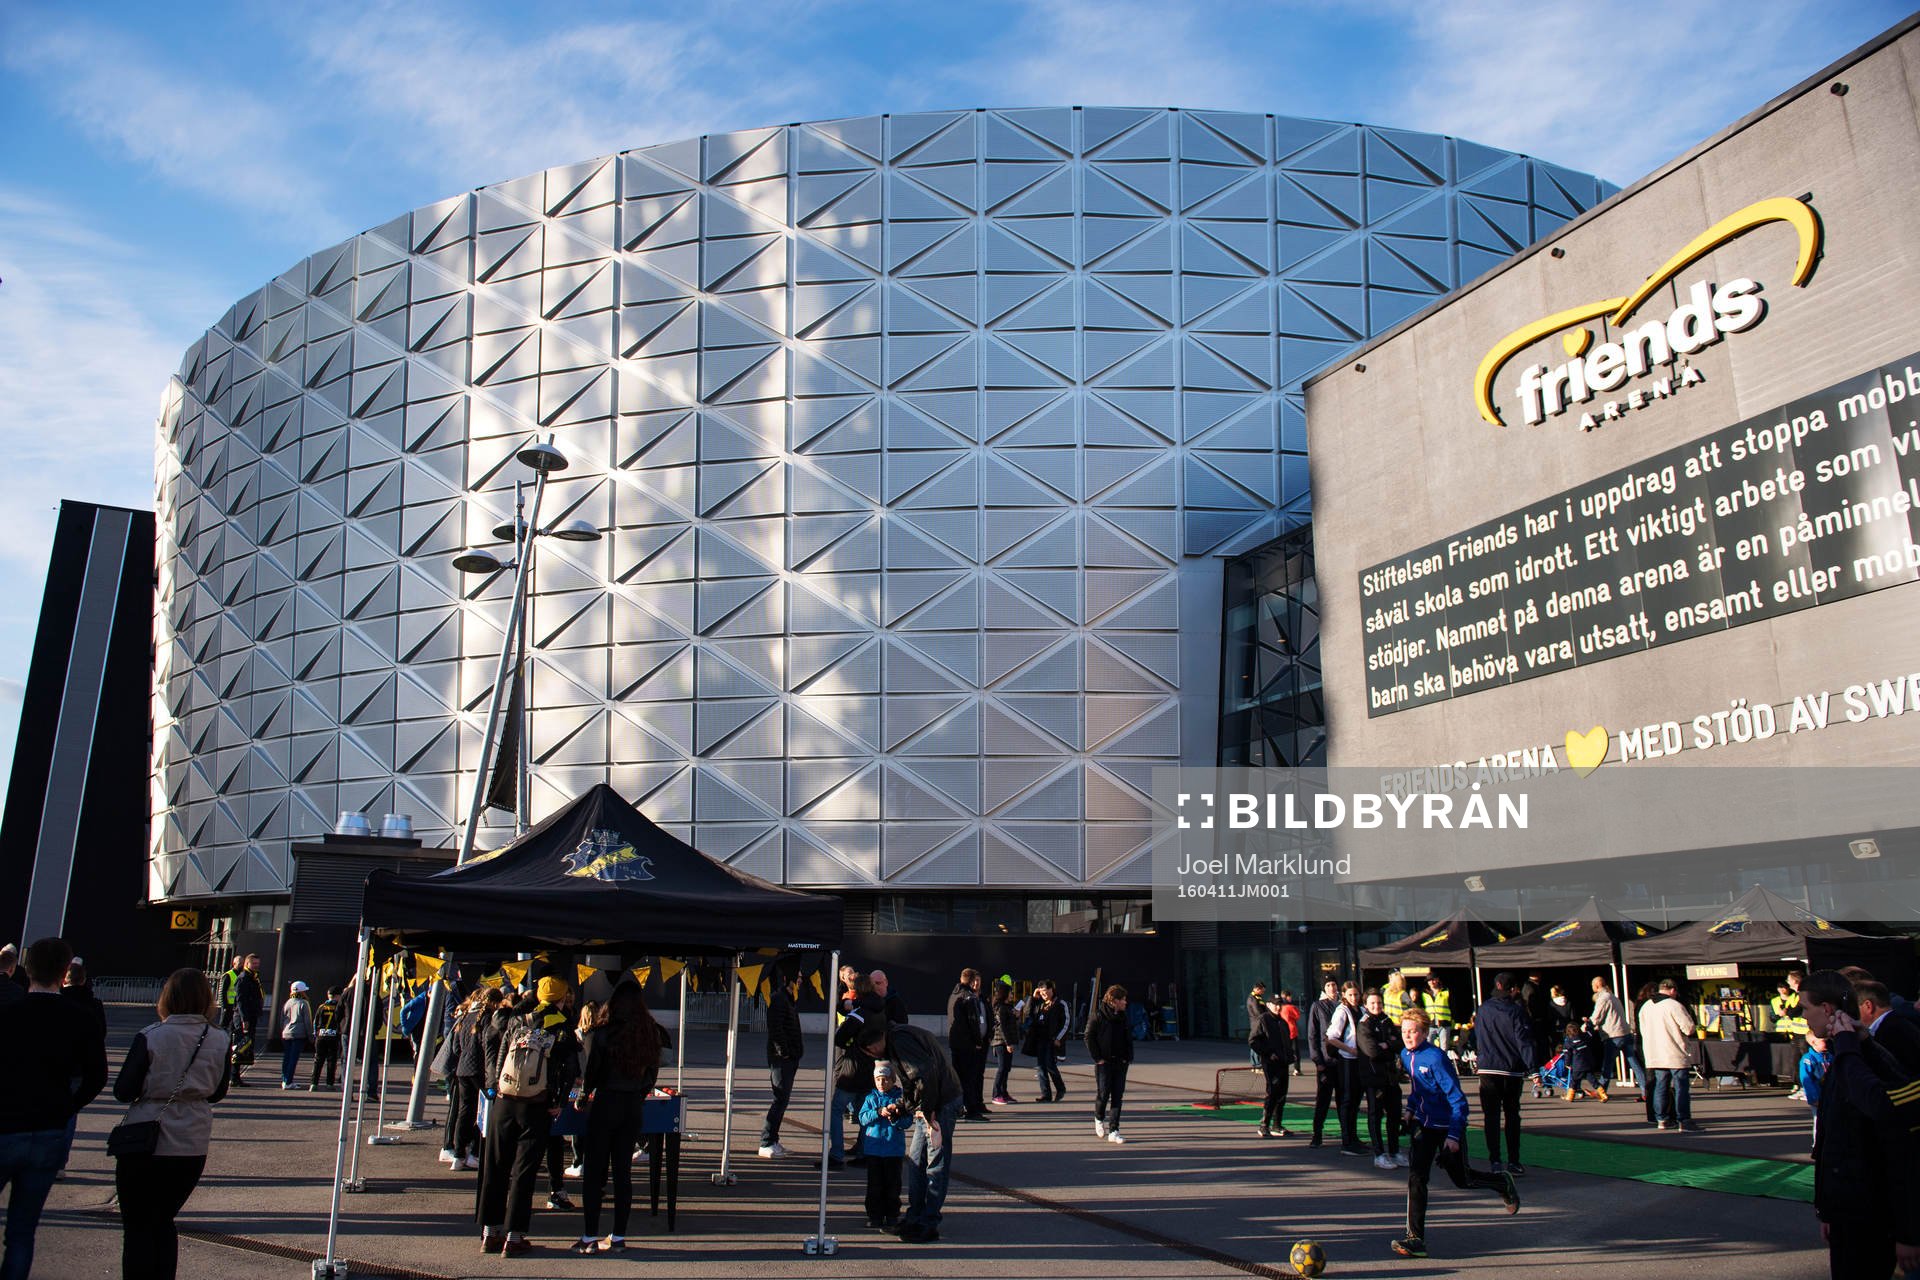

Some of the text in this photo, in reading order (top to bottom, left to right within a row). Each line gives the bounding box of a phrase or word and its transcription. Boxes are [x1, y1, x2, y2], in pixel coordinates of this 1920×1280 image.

[1515, 277, 1763, 425] friends
[1579, 365, 1702, 431] ARENA
[1363, 554, 1443, 597] Stiftelsen
[1448, 524, 1518, 566] Friends
[1525, 510, 1558, 538] har
[1566, 498, 1573, 523] i
[1580, 466, 1676, 519] uppdrag
[1685, 442, 1722, 478] att
[1731, 410, 1828, 461] stoppa
[1366, 600, 1409, 633] såväl
[1415, 585, 1463, 616] skola
[1469, 571, 1509, 599] som
[1515, 543, 1578, 584] idrott.
[1585, 526, 1619, 560] Ett
[1626, 497, 1706, 546] viktigt
[1715, 468, 1805, 516] arbete
[1816, 444, 1880, 482] som
[1369, 638, 1430, 670] stödjer.
[1436, 608, 1507, 651] Namnet
[1514, 599, 1539, 634] på
[1546, 582, 1612, 618] denna
[1619, 559, 1689, 596] arena
[1698, 544, 1725, 572] är
[1736, 534, 1768, 560] en
[1371, 686, 1408, 708] barn
[1414, 672, 1445, 698] ska
[1452, 654, 1519, 688] behöva
[1525, 640, 1573, 668] vara
[1580, 612, 1656, 653] utsatt,
[1665, 580, 1763, 631] ensamt
[1773, 567, 1841, 603] eller
[1380, 760, 1470, 800] FRIENDS
[1476, 744, 1560, 787] ARENA
[1619, 721, 1683, 763] MED
[1692, 698, 1776, 750] STÖD
[1789, 691, 1829, 734] AV
[323, 1011, 334, 1031] 7
